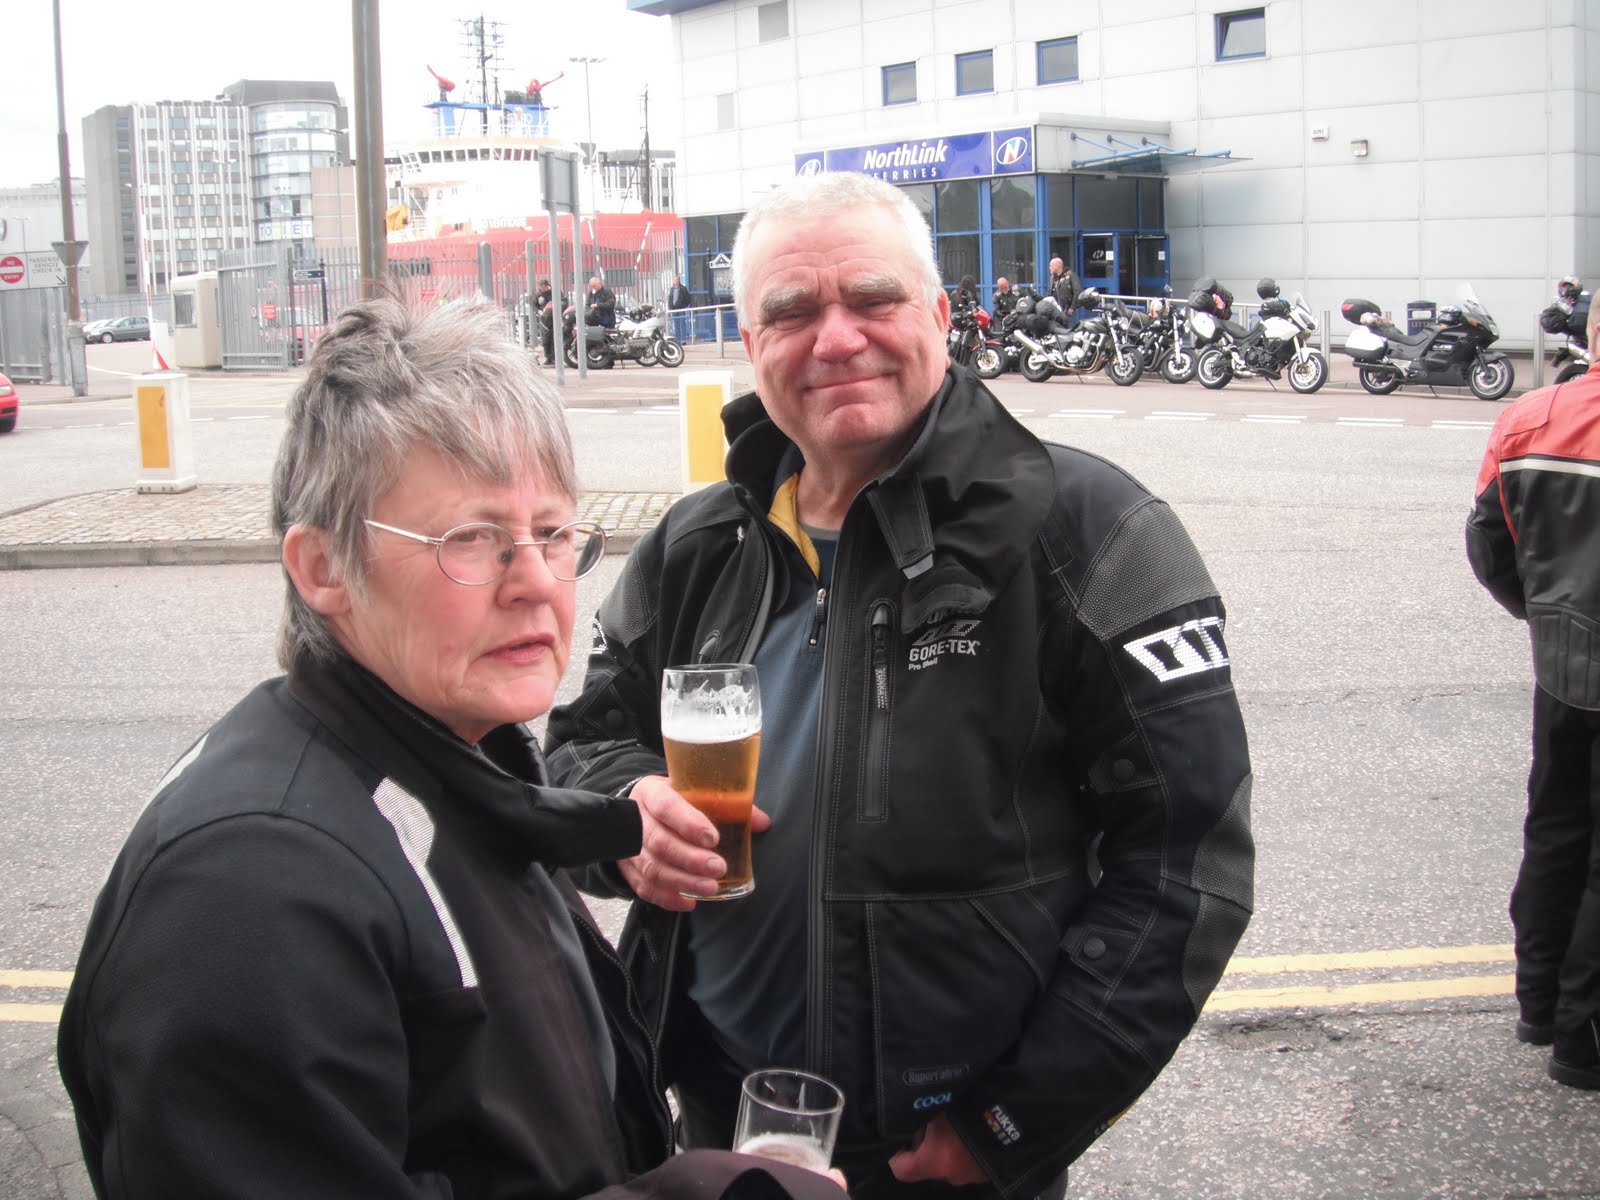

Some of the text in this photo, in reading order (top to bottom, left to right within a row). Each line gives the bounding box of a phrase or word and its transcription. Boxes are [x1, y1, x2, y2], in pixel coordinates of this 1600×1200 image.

[863, 139, 948, 169] NorthLink
[909, 639, 977, 661] GORE-TEX
[908, 658, 938, 671] Pro Shell
[991, 1104, 1021, 1142] rukka
